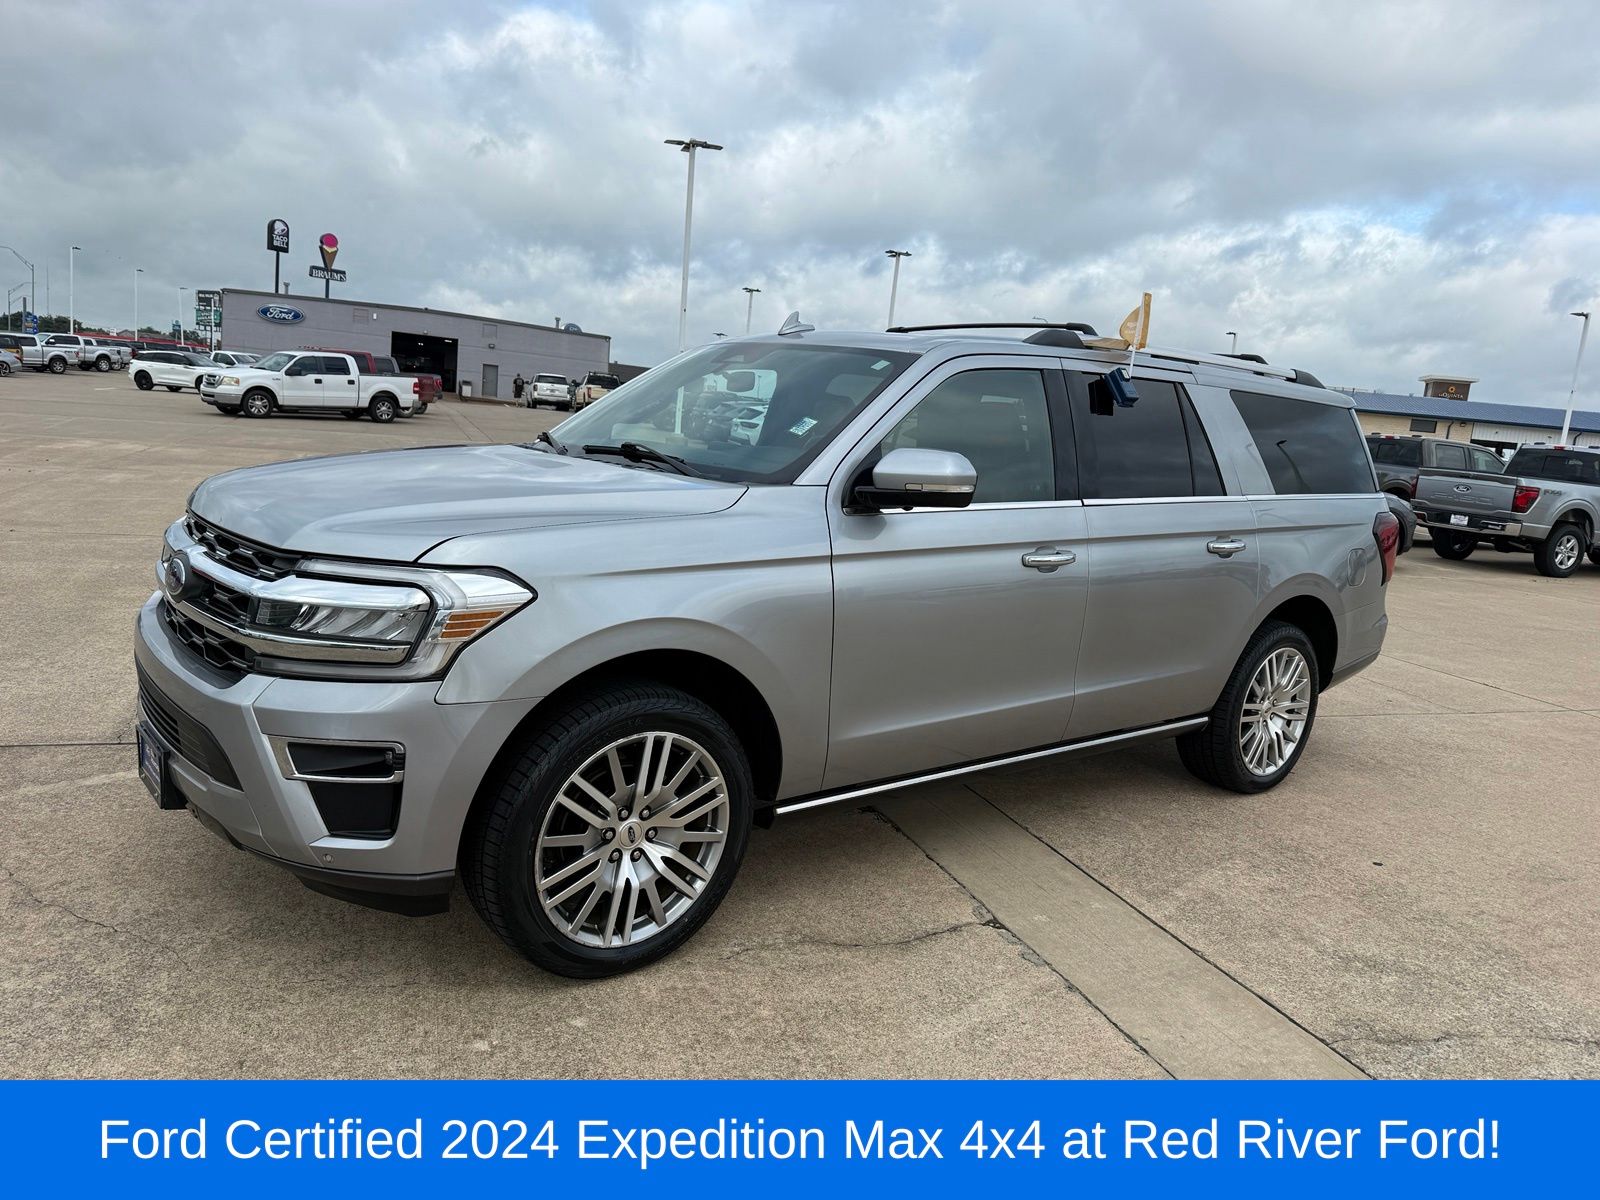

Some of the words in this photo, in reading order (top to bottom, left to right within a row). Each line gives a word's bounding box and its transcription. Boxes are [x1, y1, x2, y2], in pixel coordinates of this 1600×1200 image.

[272, 234, 288, 242] TACO
[273, 240, 288, 248] BELL
[266, 305, 295, 320] Ford
